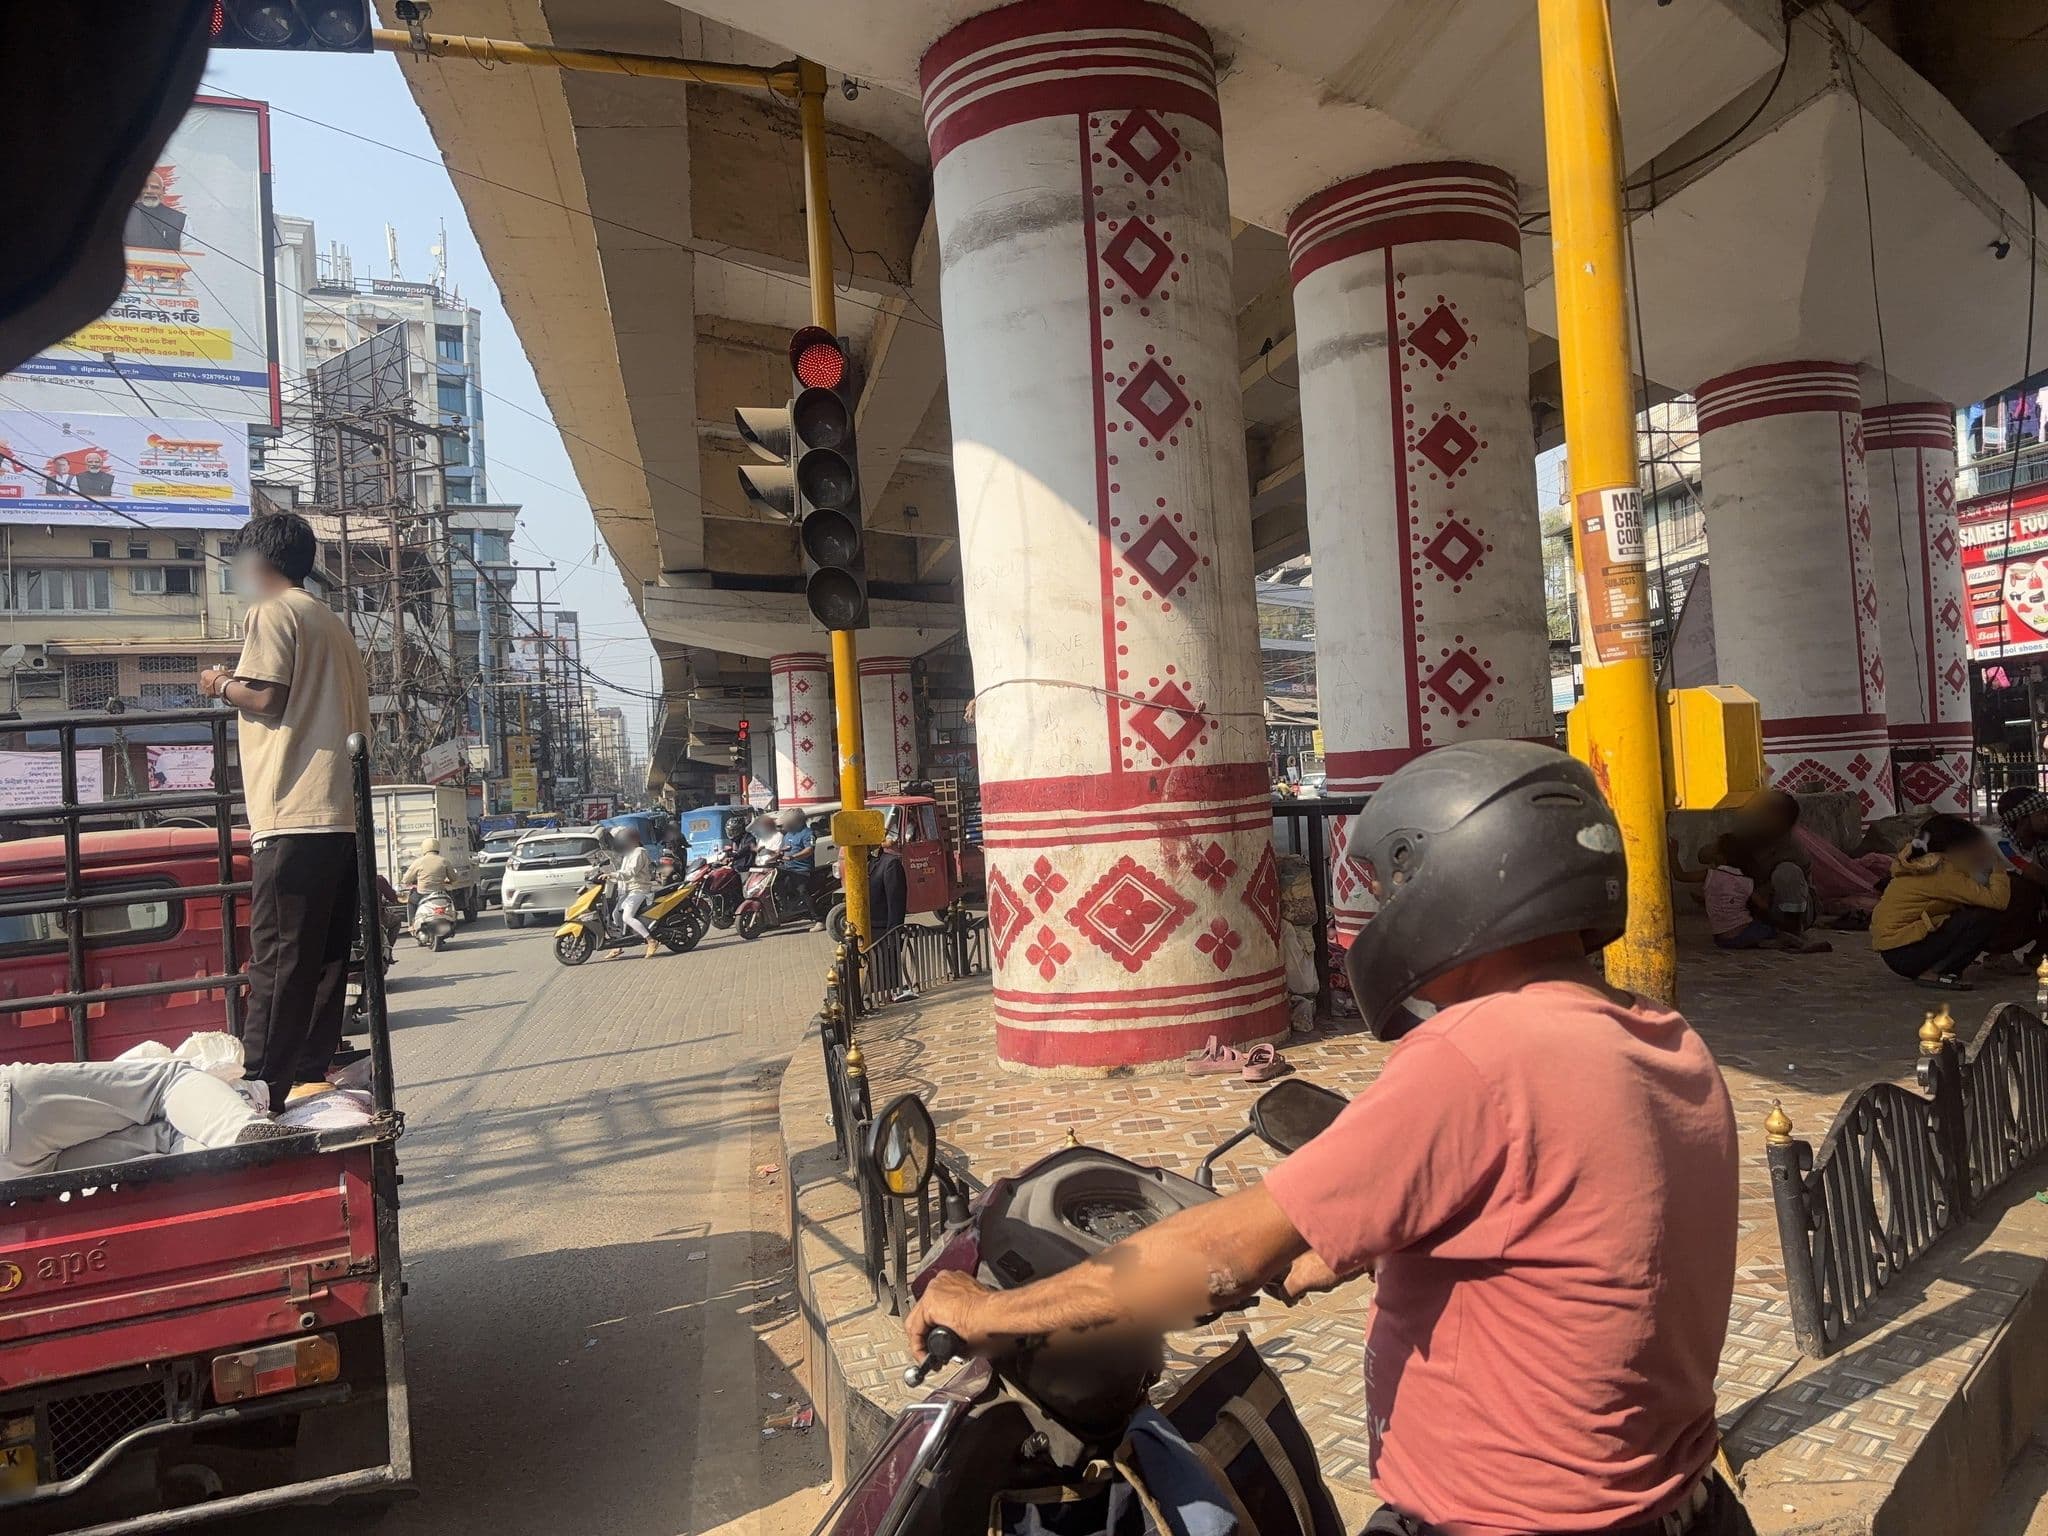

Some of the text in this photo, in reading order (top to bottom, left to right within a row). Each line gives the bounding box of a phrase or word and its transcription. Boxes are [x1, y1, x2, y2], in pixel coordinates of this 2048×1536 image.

[1977, 649, 1989, 659] All
[2019, 643, 2043, 653] shoes
[37, 1240, 109, 1285] apé
